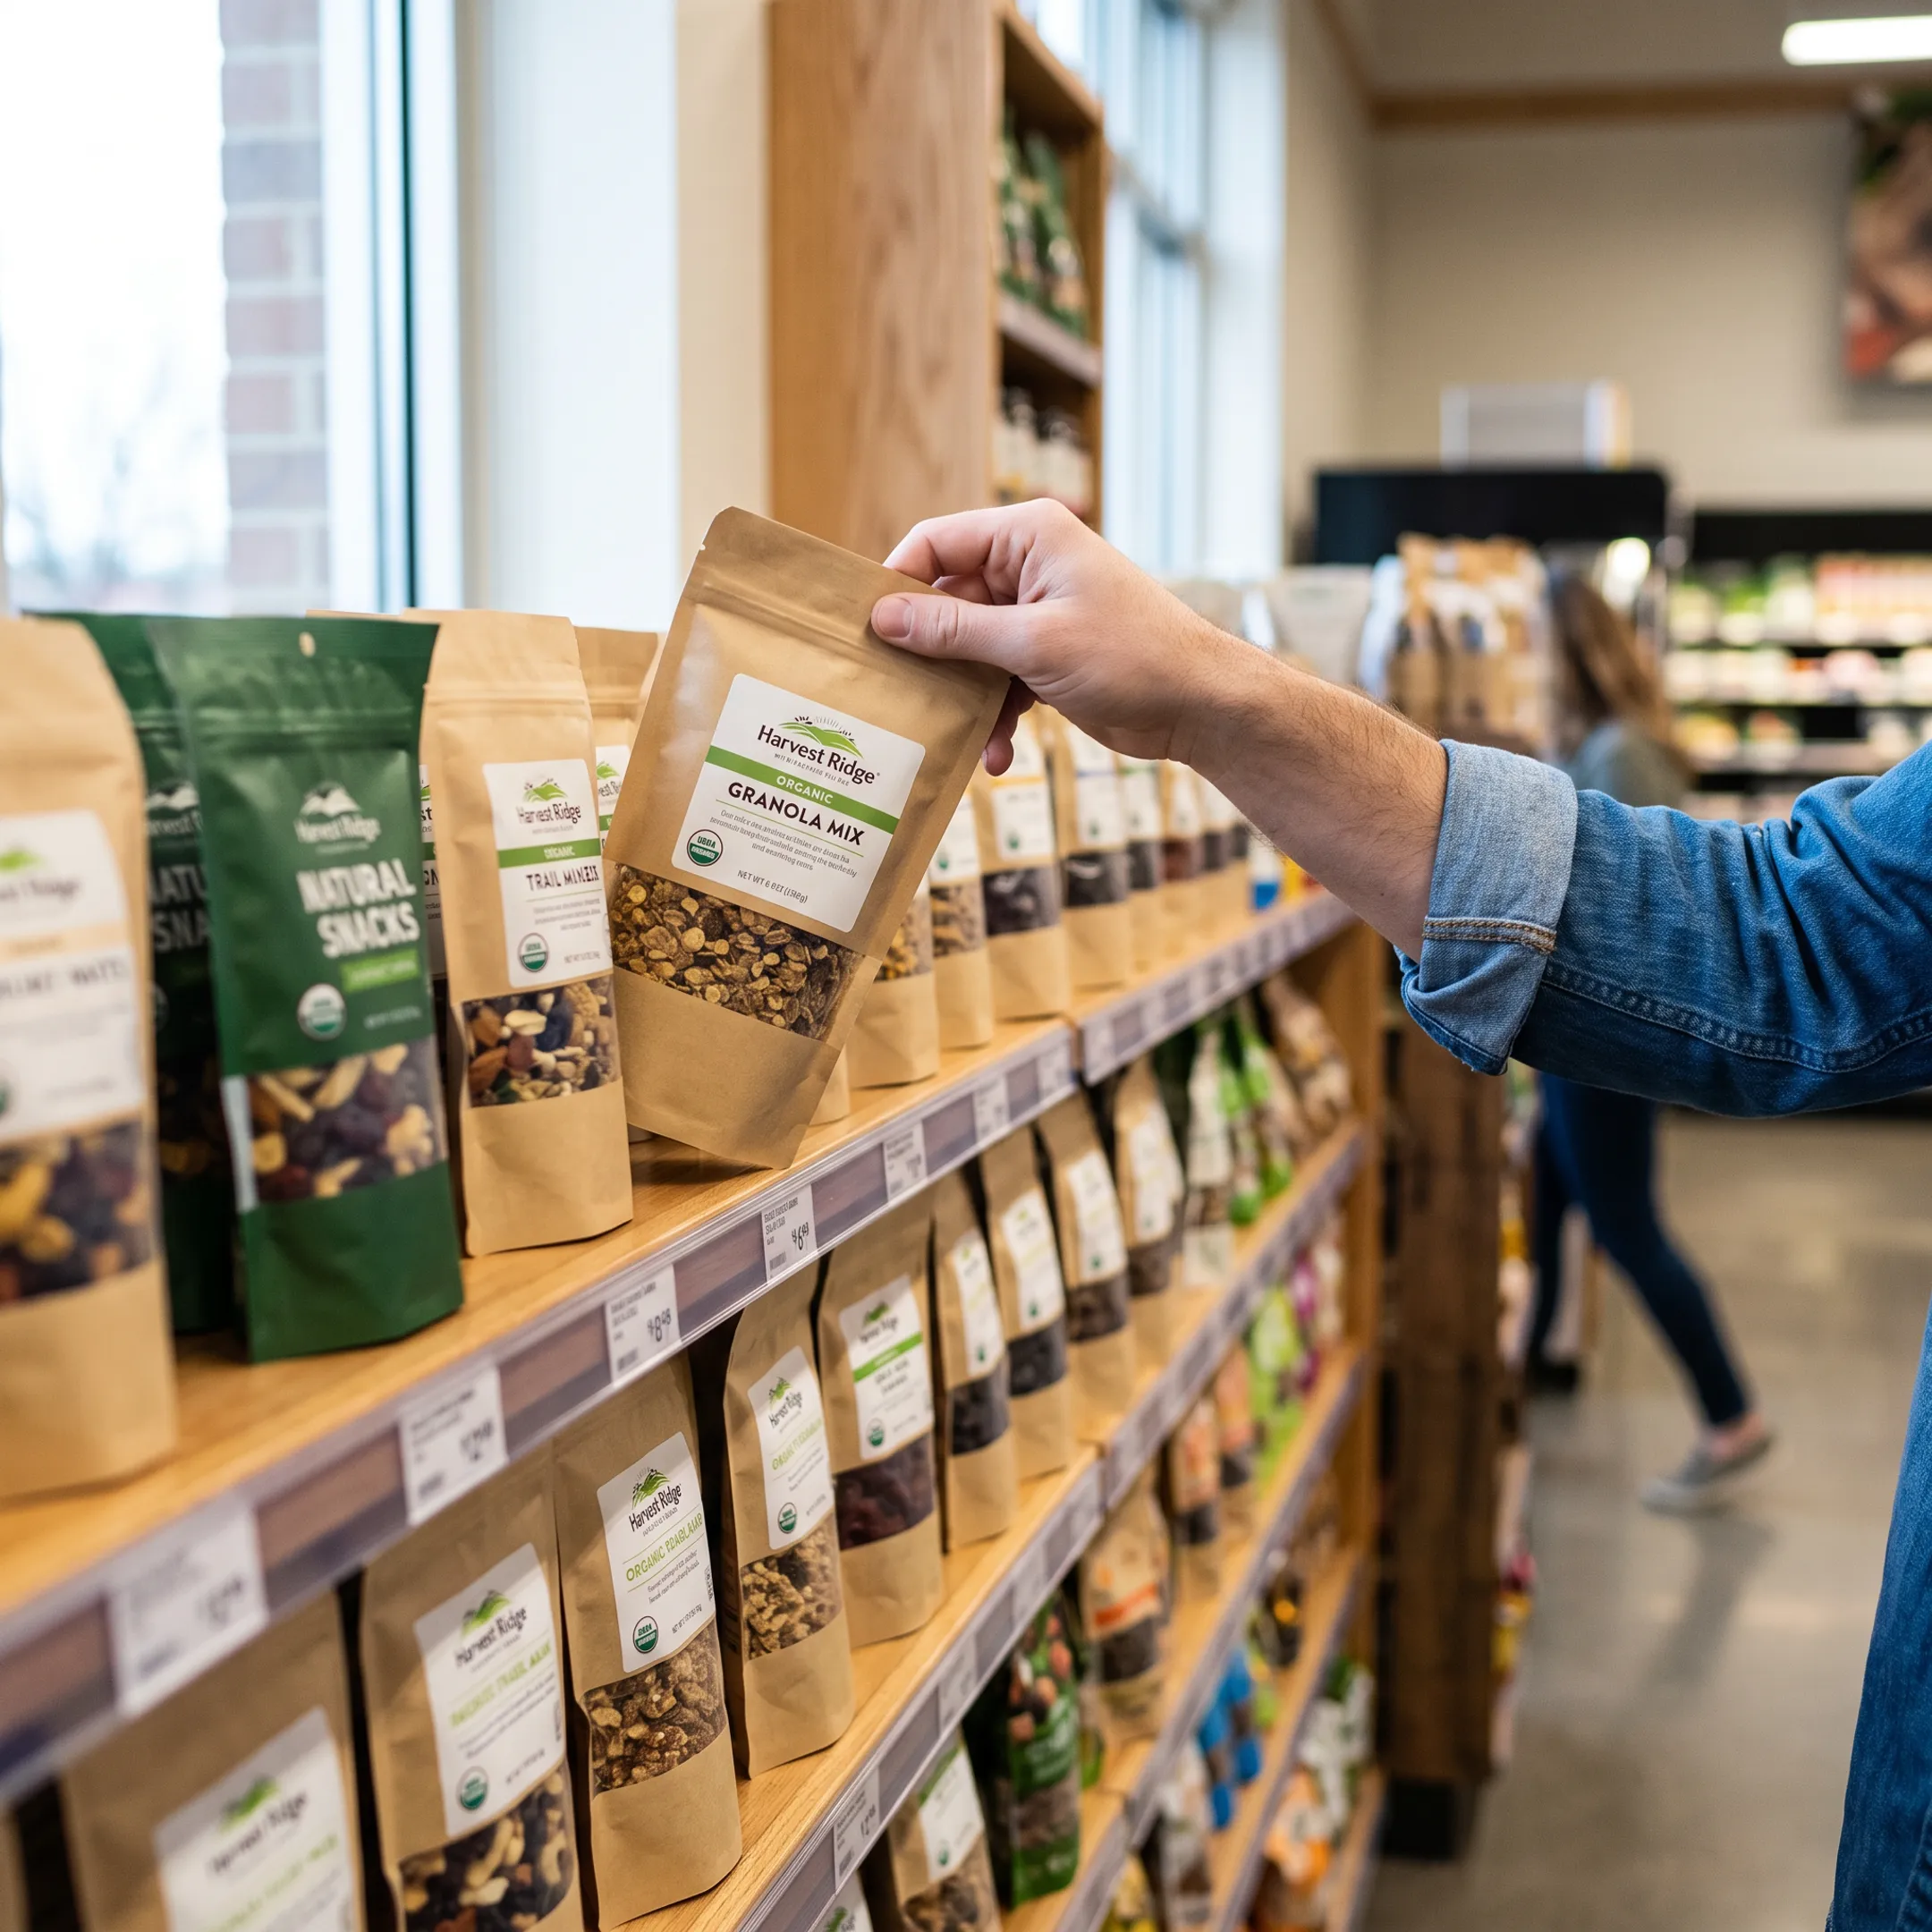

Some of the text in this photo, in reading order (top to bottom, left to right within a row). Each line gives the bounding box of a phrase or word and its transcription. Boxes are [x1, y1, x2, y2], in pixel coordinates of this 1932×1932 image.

[758, 724, 826, 764] Harvest
[827, 752, 875, 784] Ridge
[776, 775, 834, 804] ORGANIC
[553, 803, 580, 825] Ridge
[728, 782, 821, 830] GRANOLA
[826, 818, 865, 846] MIX
[296, 858, 417, 914] NATURAL
[526, 871, 562, 891] TRAIL
[317, 901, 420, 959] SNACKS
[629, 1499, 660, 1532] Harvest
[626, 1546, 665, 1581] ORGANIC
